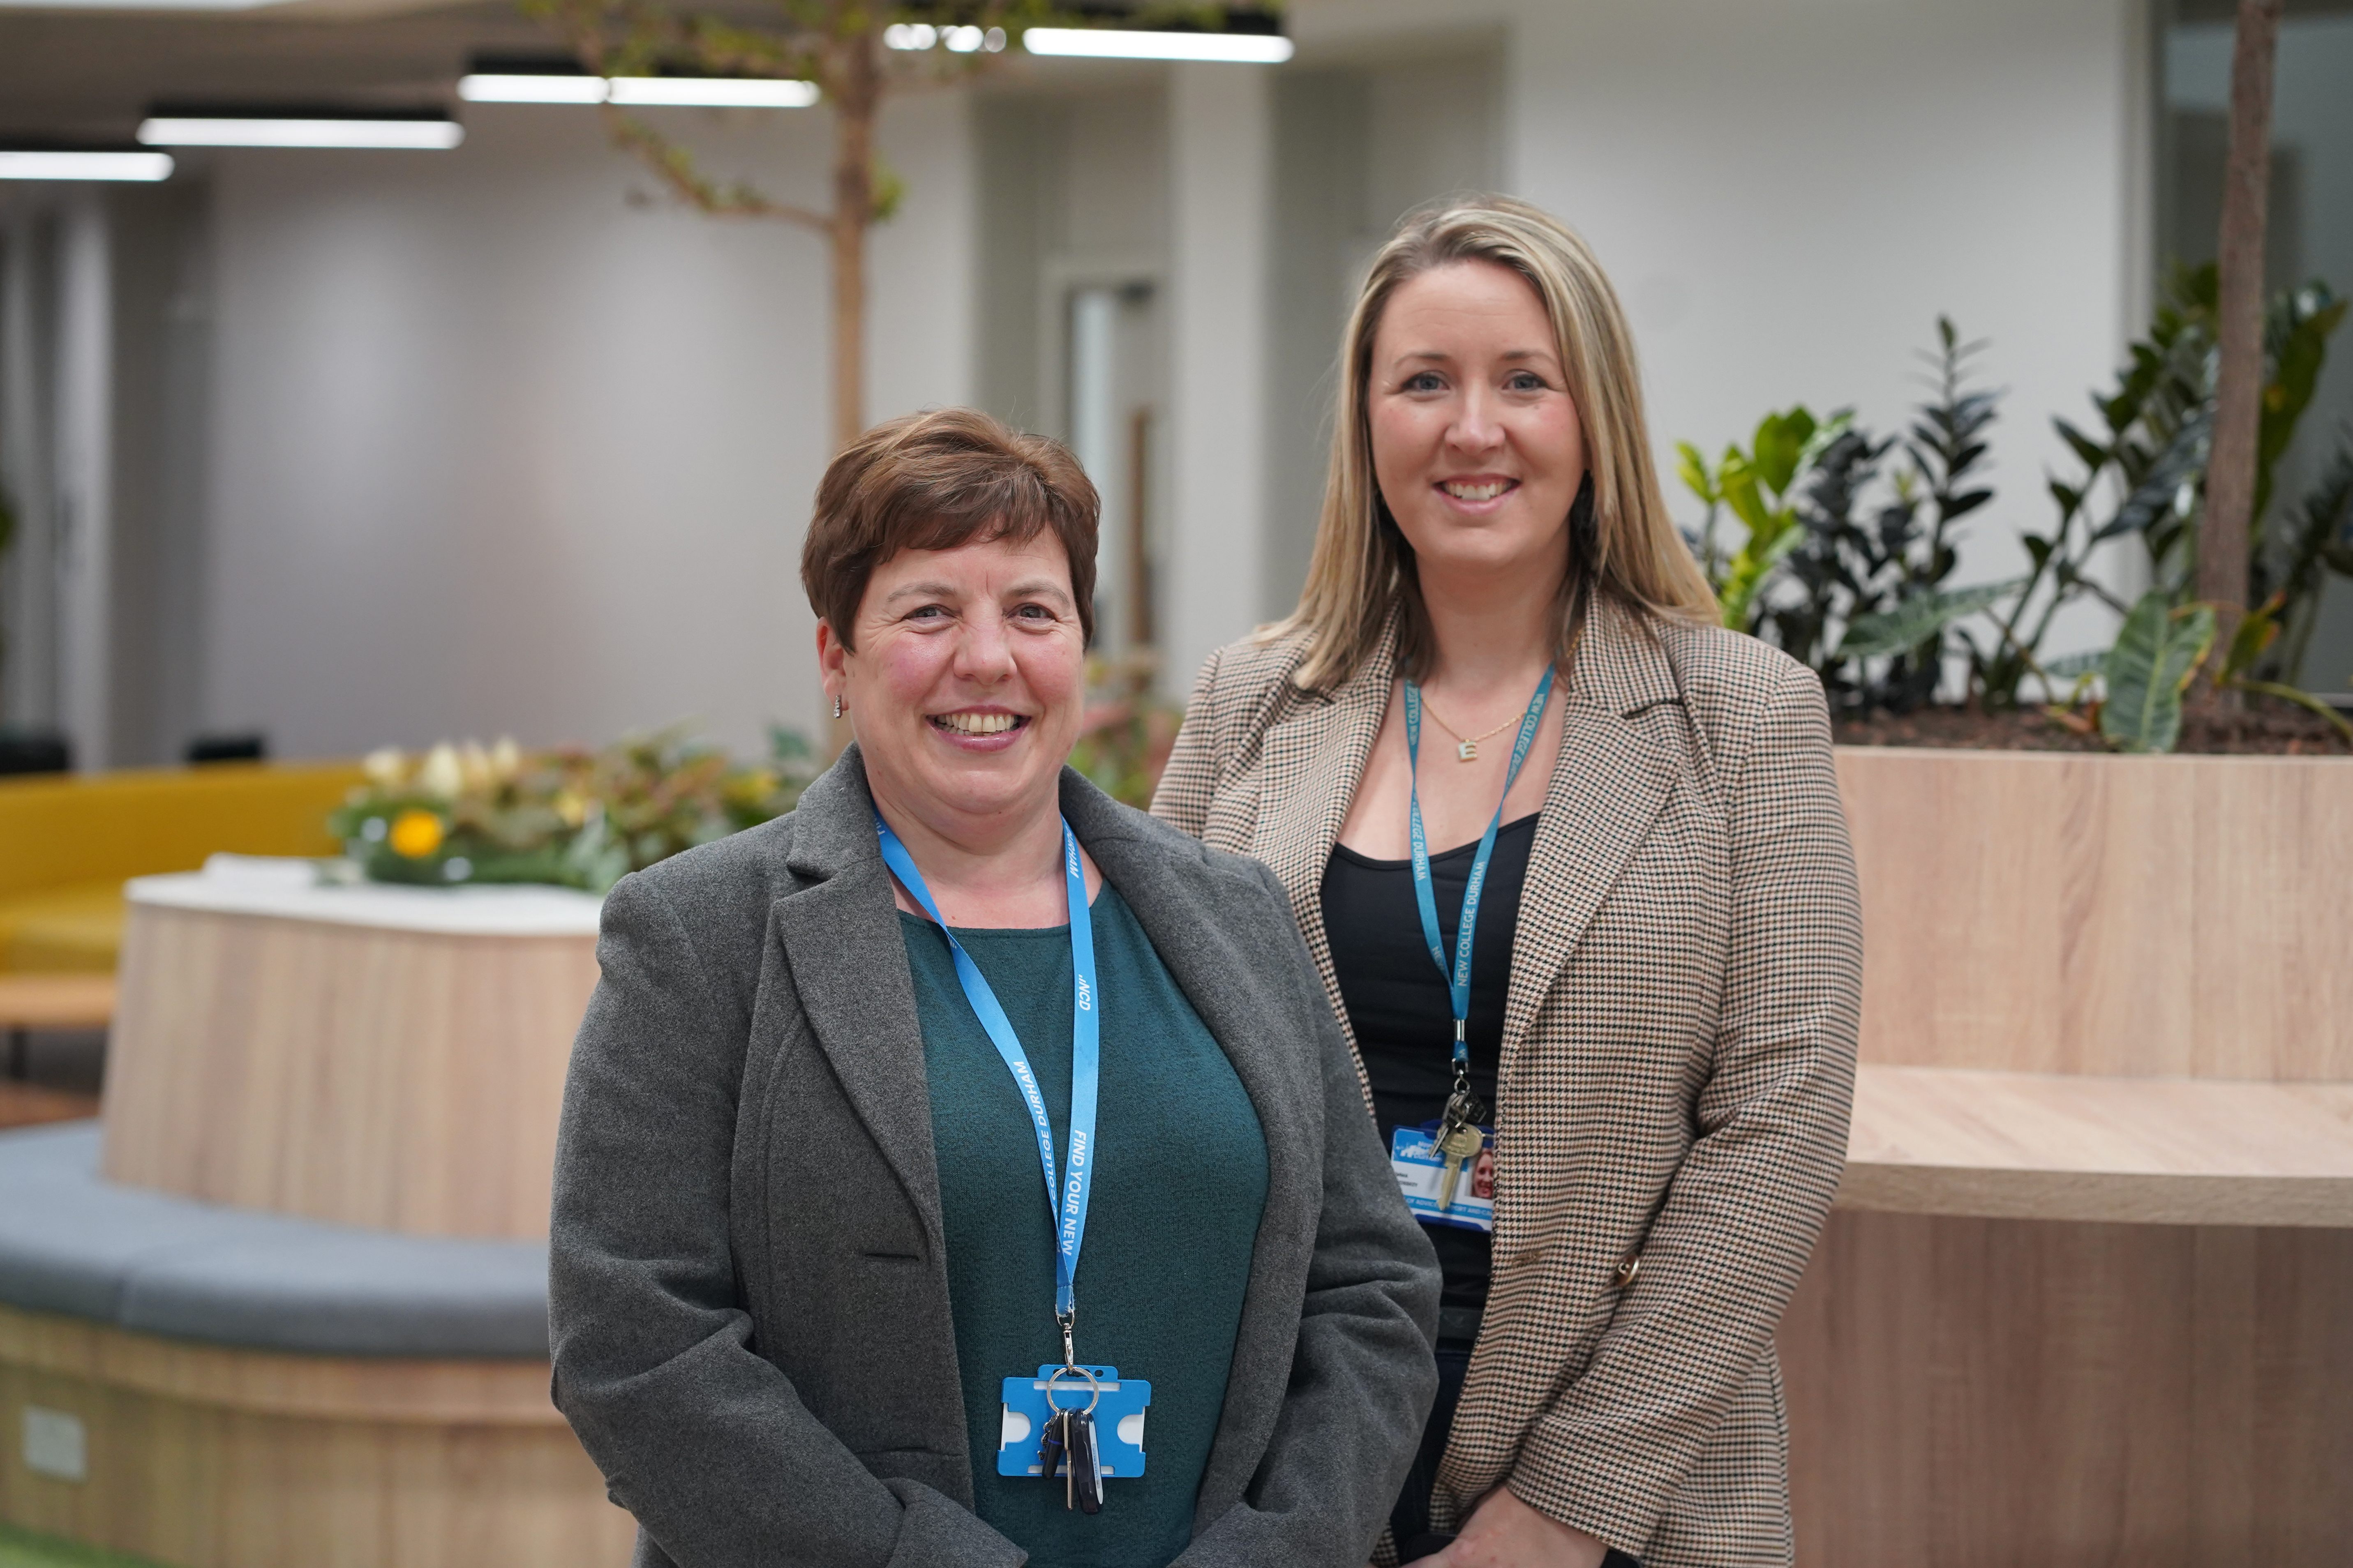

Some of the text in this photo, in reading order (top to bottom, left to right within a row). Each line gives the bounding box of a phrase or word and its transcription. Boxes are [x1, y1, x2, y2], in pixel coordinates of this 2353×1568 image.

[1531, 693, 1545, 714] NEW
[1515, 714, 1538, 755] COLLEGE
[1066, 828, 1080, 879] DURHAM
[1413, 841, 1427, 881] DURHAM
[1457, 861, 1485, 987] NEW COLLEGE DURHAM
[1013, 1061, 1056, 1201] COLLEGE DURHAM
[1061, 1130, 1087, 1256] FIND YOUR NEW
